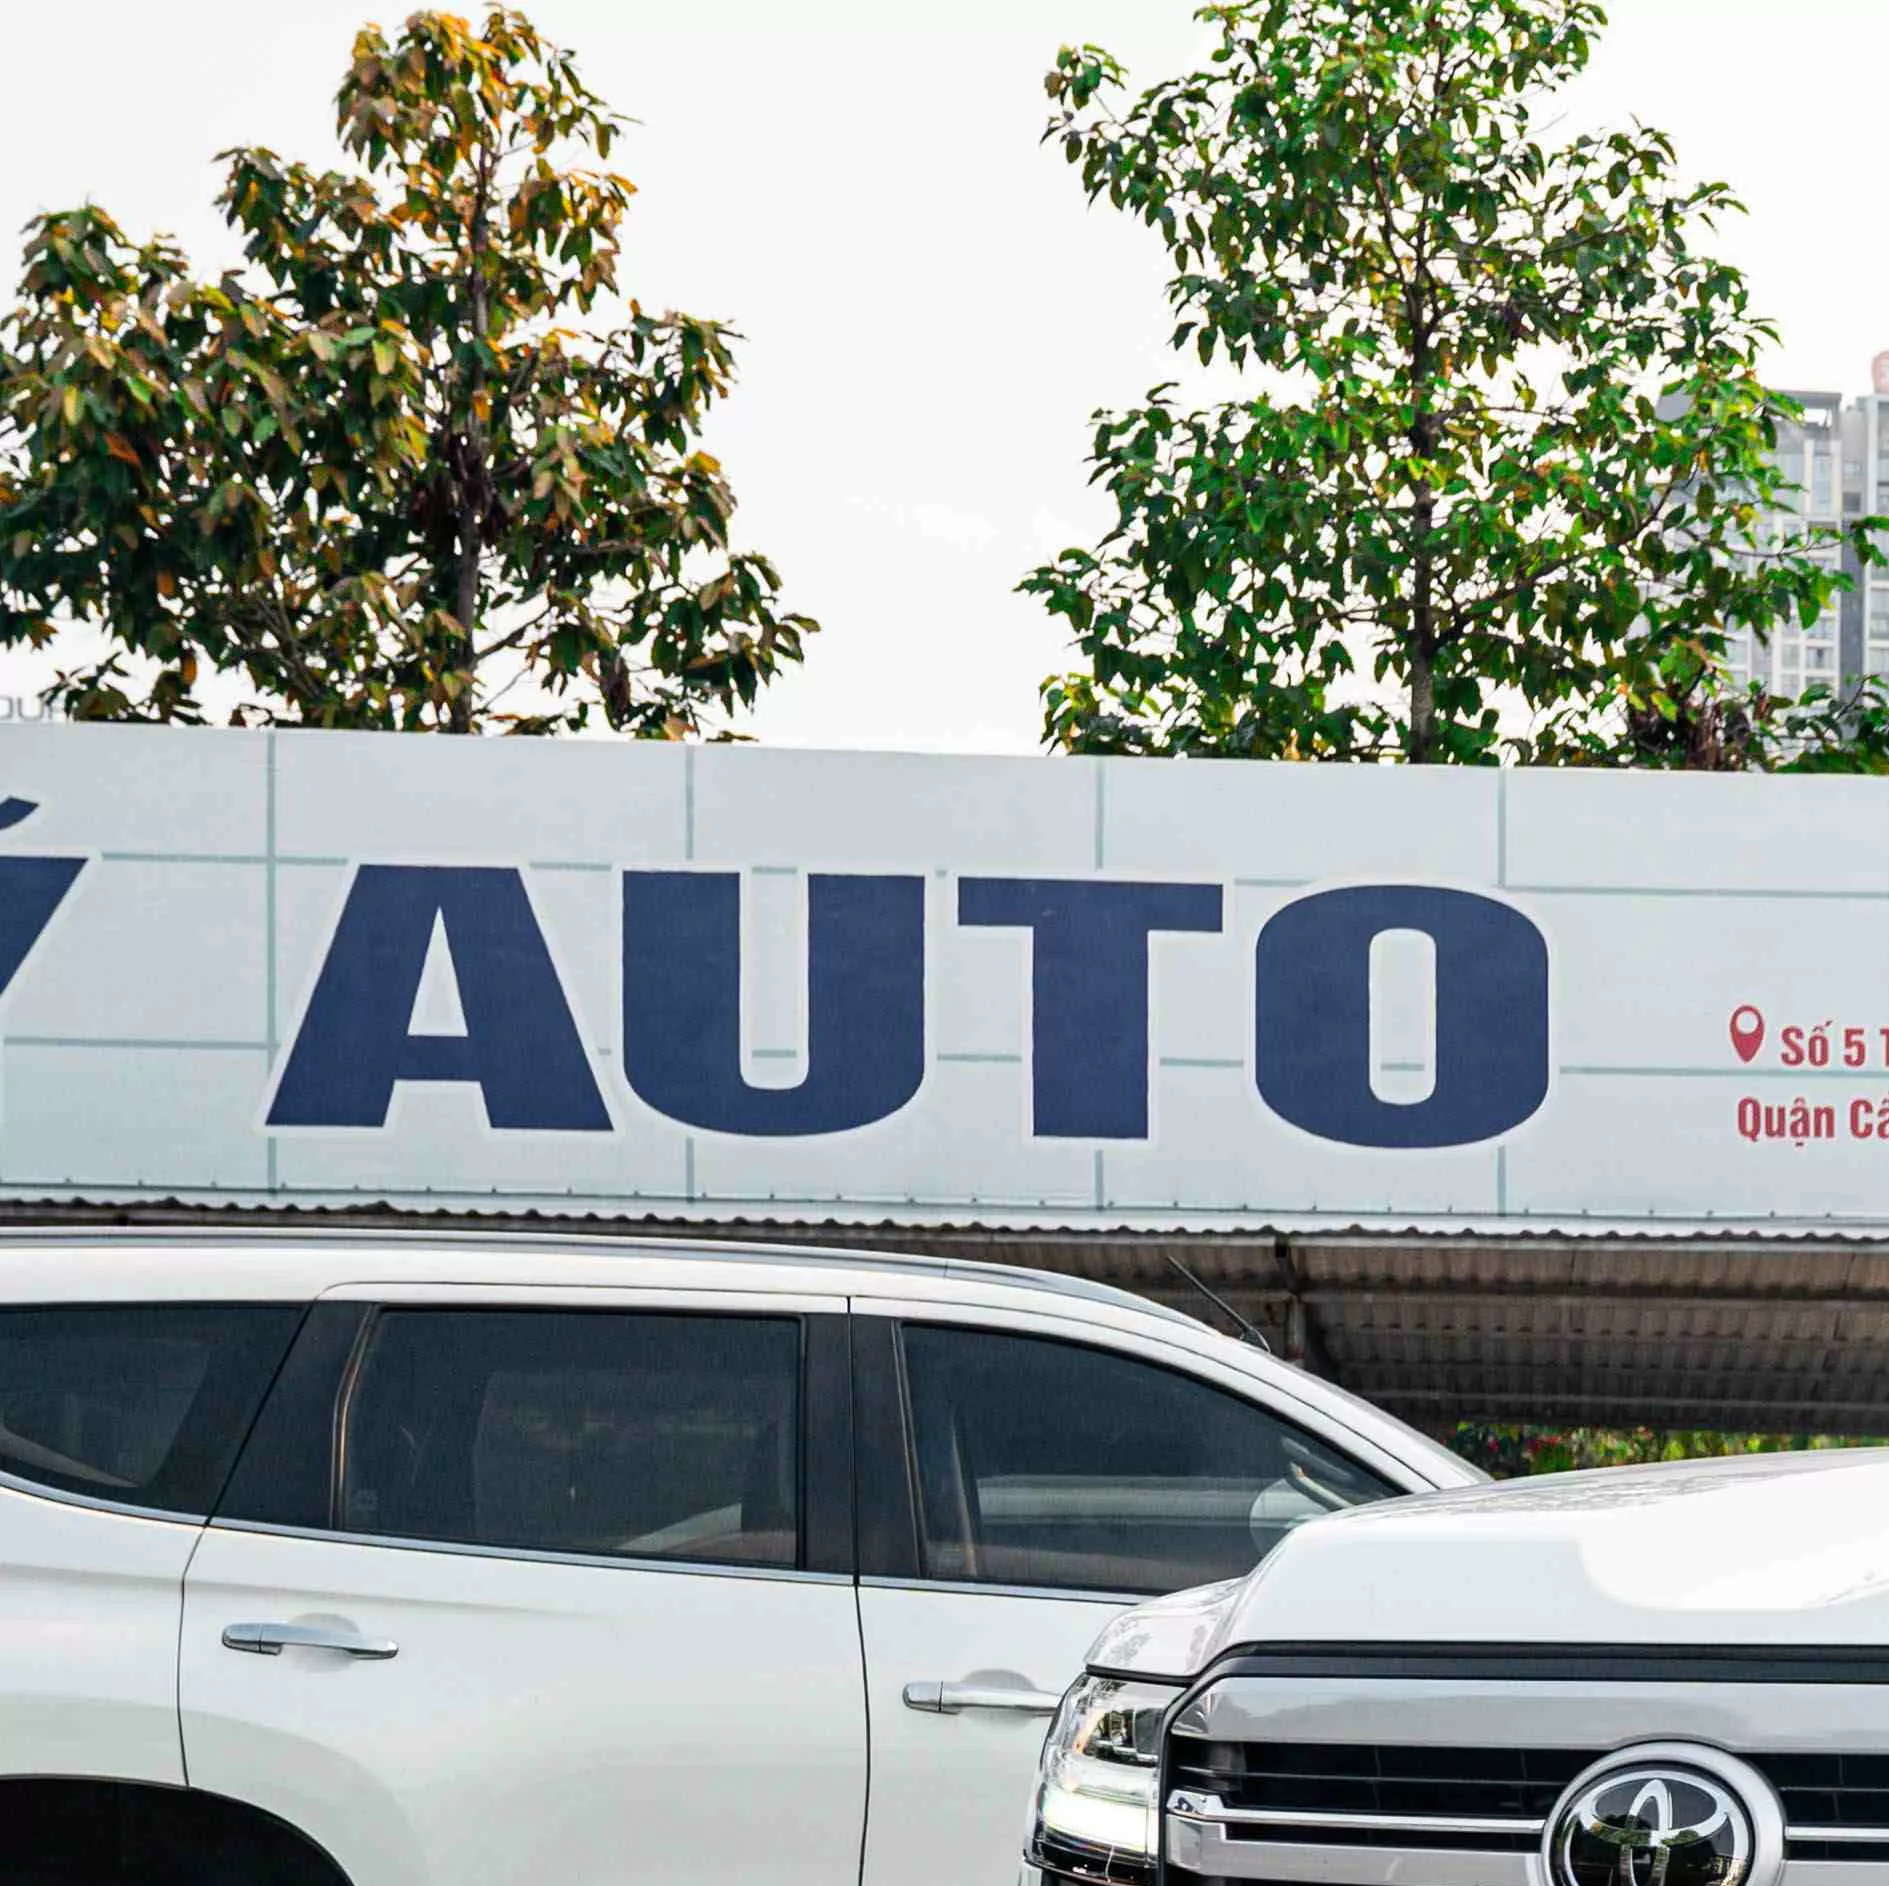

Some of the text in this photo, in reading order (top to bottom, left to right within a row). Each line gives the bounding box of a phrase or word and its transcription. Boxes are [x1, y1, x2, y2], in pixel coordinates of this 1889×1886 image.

[266, 863, 1549, 1150] AUTO
[1780, 1019, 1834, 1067] Số
[1843, 1028, 1867, 1068] 5
[1737, 1096, 1836, 1148] Quận
